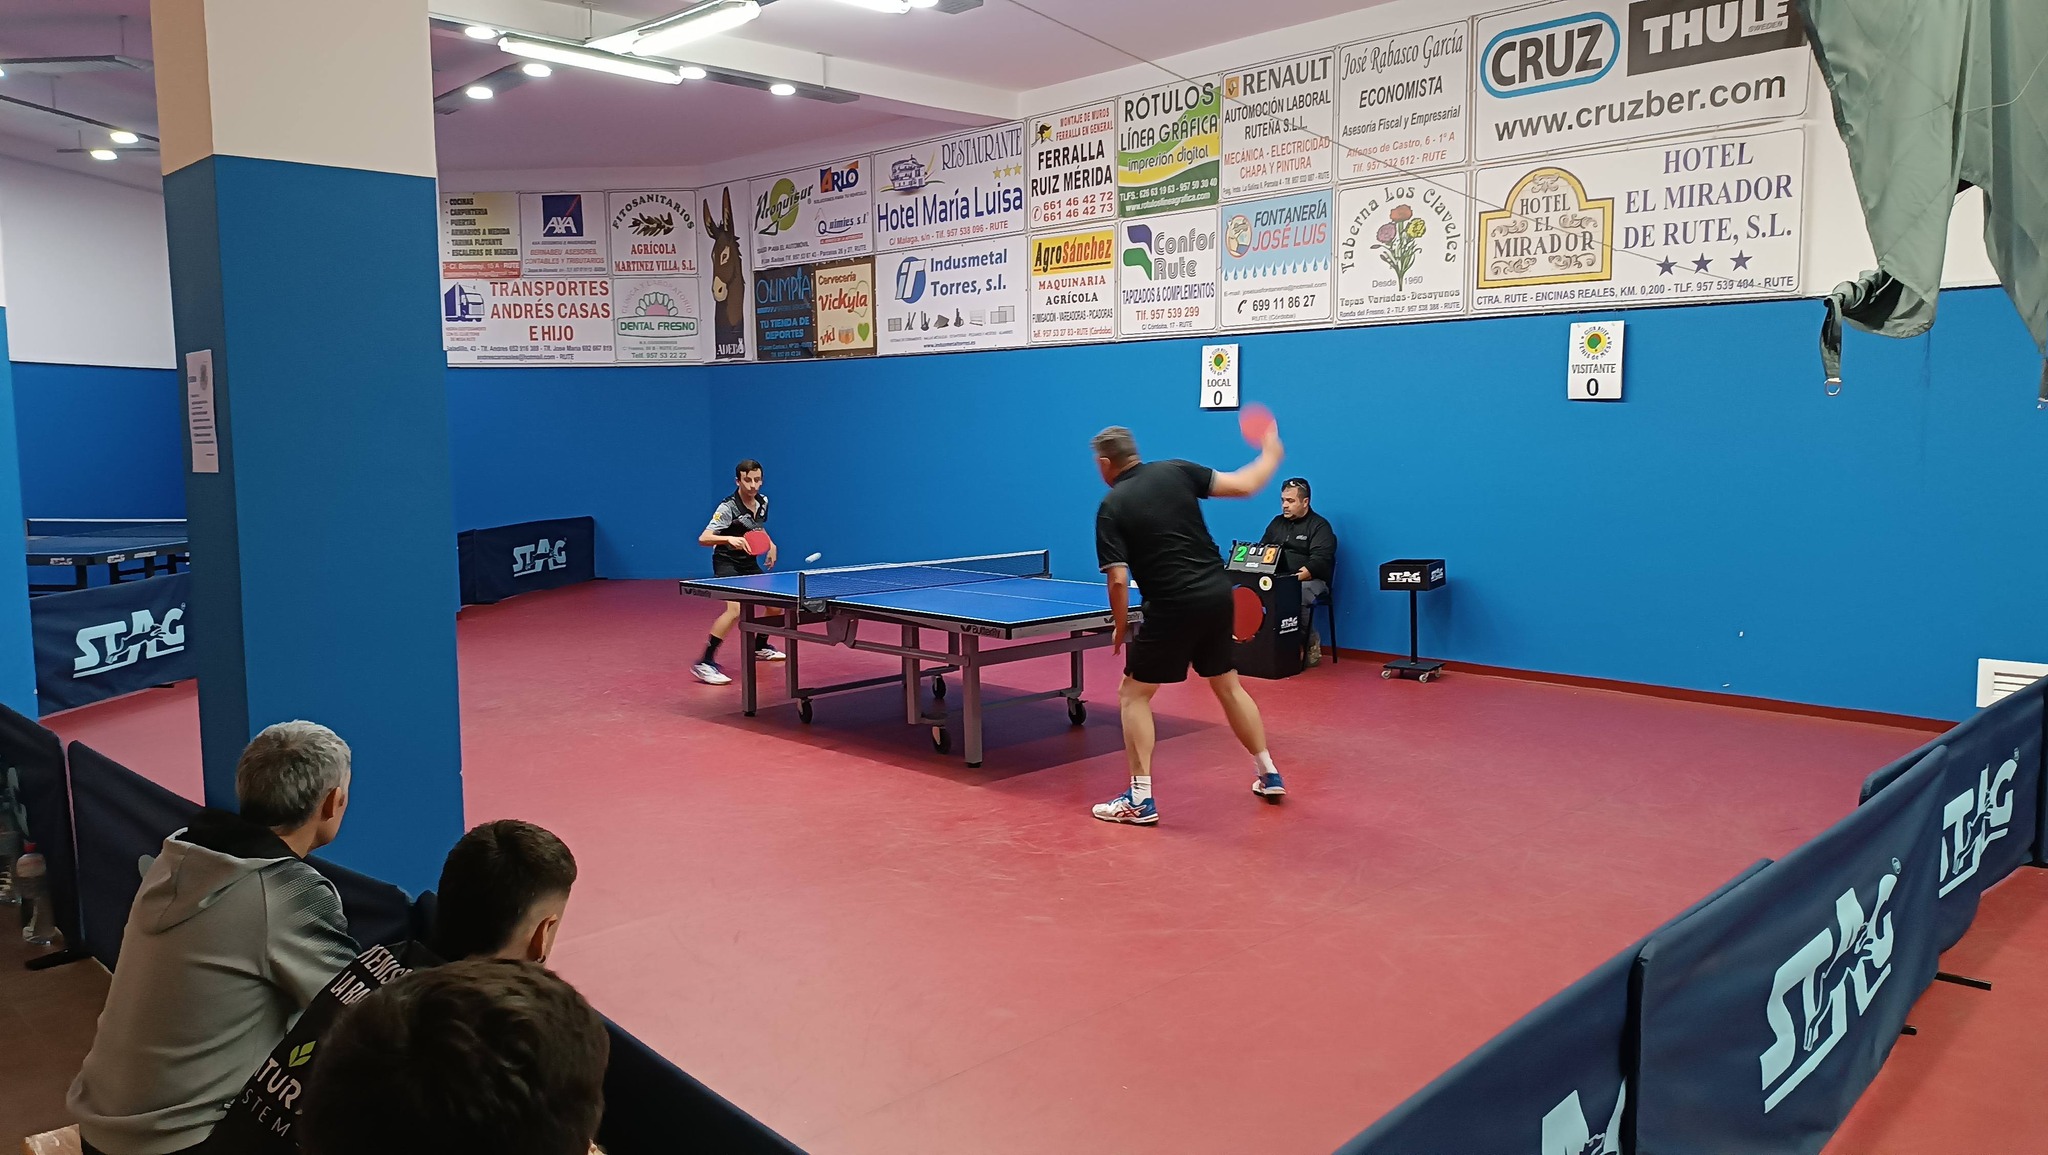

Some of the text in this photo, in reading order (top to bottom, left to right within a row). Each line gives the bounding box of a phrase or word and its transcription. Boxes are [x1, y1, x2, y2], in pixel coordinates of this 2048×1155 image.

[1643, 0, 1789, 54] THULE
[1342, 28, 1463, 81] José Rabasco García
[1491, 24, 1603, 87] CRUZ
[1243, 56, 1332, 96] RENAULT
[1124, 82, 1214, 122] RÓTULOS
[1359, 75, 1443, 109] ECONOMISTA
[1060, 108, 1110, 127] MONTAJE DE MUROS
[1224, 89, 1331, 124] AUTOMOCIÓN LABORAL
[1495, 75, 1786, 141] www.cruzber.com
[1056, 121, 1113, 141] FERRALLA EN GENERAL
[1159, 114, 1218, 142] GRÁFICA
[1245, 119, 1281, 140] RUTEÑA
[1342, 105, 1461, 138] Asesoría Fiscal y Empresarial
[941, 127, 1022, 171] RESTAURANTE
[1224, 136, 1330, 166] MECÁNICA ELECTRICIDAD
[1380, 143, 1390, 153] de
[1392, 139, 1422, 151] Castro,
[1425, 136, 1430, 146] 6
[1448, 131, 1455, 142] A
[1038, 140, 1105, 171] FERRALLA
[1128, 144, 1209, 175] impresión digital
[1366, 160, 1380, 171] 957
[1400, 155, 1415, 166] 612
[1422, 150, 1447, 163] RUTE
[1663, 142, 1754, 174] HOTEL
[1240, 163, 1267, 179] CHAPA
[1269, 162, 1275, 173] Y
[1277, 156, 1312, 173] PINTURA
[820, 166, 859, 193] ARLO
[1031, 165, 1113, 197] RUIZ MÉRIDA
[1043, 191, 1113, 211] 661 46 42 72
[1520, 193, 1571, 215] HOTEL
[1625, 174, 1793, 214] EL MIRADOR
[612, 194, 695, 230] FITOSANITARIOS
[877, 182, 1023, 233] Hotel María Luisa
[1043, 202, 1113, 222] 661 46 42 73
[1254, 199, 1328, 228] FONTANERÍA
[543, 216, 577, 234] AXA
[947, 228, 958, 237] 957
[989, 220, 1009, 231] RUTE
[1341, 186, 1461, 274] Taberna Los Claveles
[1534, 217, 1554, 232] EL
[1624, 213, 1792, 250] DE RUTE, S.L.
[631, 241, 677, 255] AGRÍCOLA
[1154, 227, 1216, 256] Confor
[1252, 221, 1327, 252] JOSÉ LUIS
[1493, 230, 1596, 259] MIRADOR
[614, 261, 654, 272] MARTINEZ
[656, 260, 680, 272] VILLA,
[681, 260, 696, 271] S.L.
[931, 249, 1007, 272] Indusmetal
[1034, 236, 1113, 273] AgroSánchez
[1153, 256, 1197, 281] Rute
[489, 281, 609, 297] TRANSPORTES
[756, 267, 812, 304] OLIMPIA
[931, 274, 1007, 297] Torres, s.l.
[1038, 275, 1106, 291] MAQUINARIA
[1122, 287, 1155, 304] TAPIZADOS
[1162, 282, 1214, 301] COMPLEMENTOS
[1372, 279, 1397, 288] Desde
[1476, 276, 1794, 306] CTRA. RUTE ENCINAS REALES, KM. 0,200 TLF. 957 539 RUTE
[491, 299, 610, 319] ANDRÉS CASAS
[1046, 291, 1098, 306] AGRÍCOLA
[1252, 294, 1316, 311] 699 11 86 27
[1340, 297, 1364, 307] Tapas
[760, 316, 810, 329] TU TIENDA DE
[1150, 308, 1164, 320] 957
[1167, 307, 1182, 319] 539
[1184, 306, 1200, 318] 299
[529, 325, 574, 341] E HIJO
[620, 321, 695, 331] DENTAL FRESNO
[765, 329, 804, 340] DEPORTES
[1572, 363, 1616, 374] VISITANTE
[1207, 379, 1231, 387] LOCAL
[1586, 378, 1599, 396] 0
[1213, 390, 1223, 406] 0
[512, 538, 566, 577] STAG
[1233, 545, 1248, 562] 2
[1263, 547, 1276, 564] 8
[1387, 571, 1421, 583] STAG
[72, 608, 185, 678] STAG
[1760, 874, 1898, 1114] STAG
